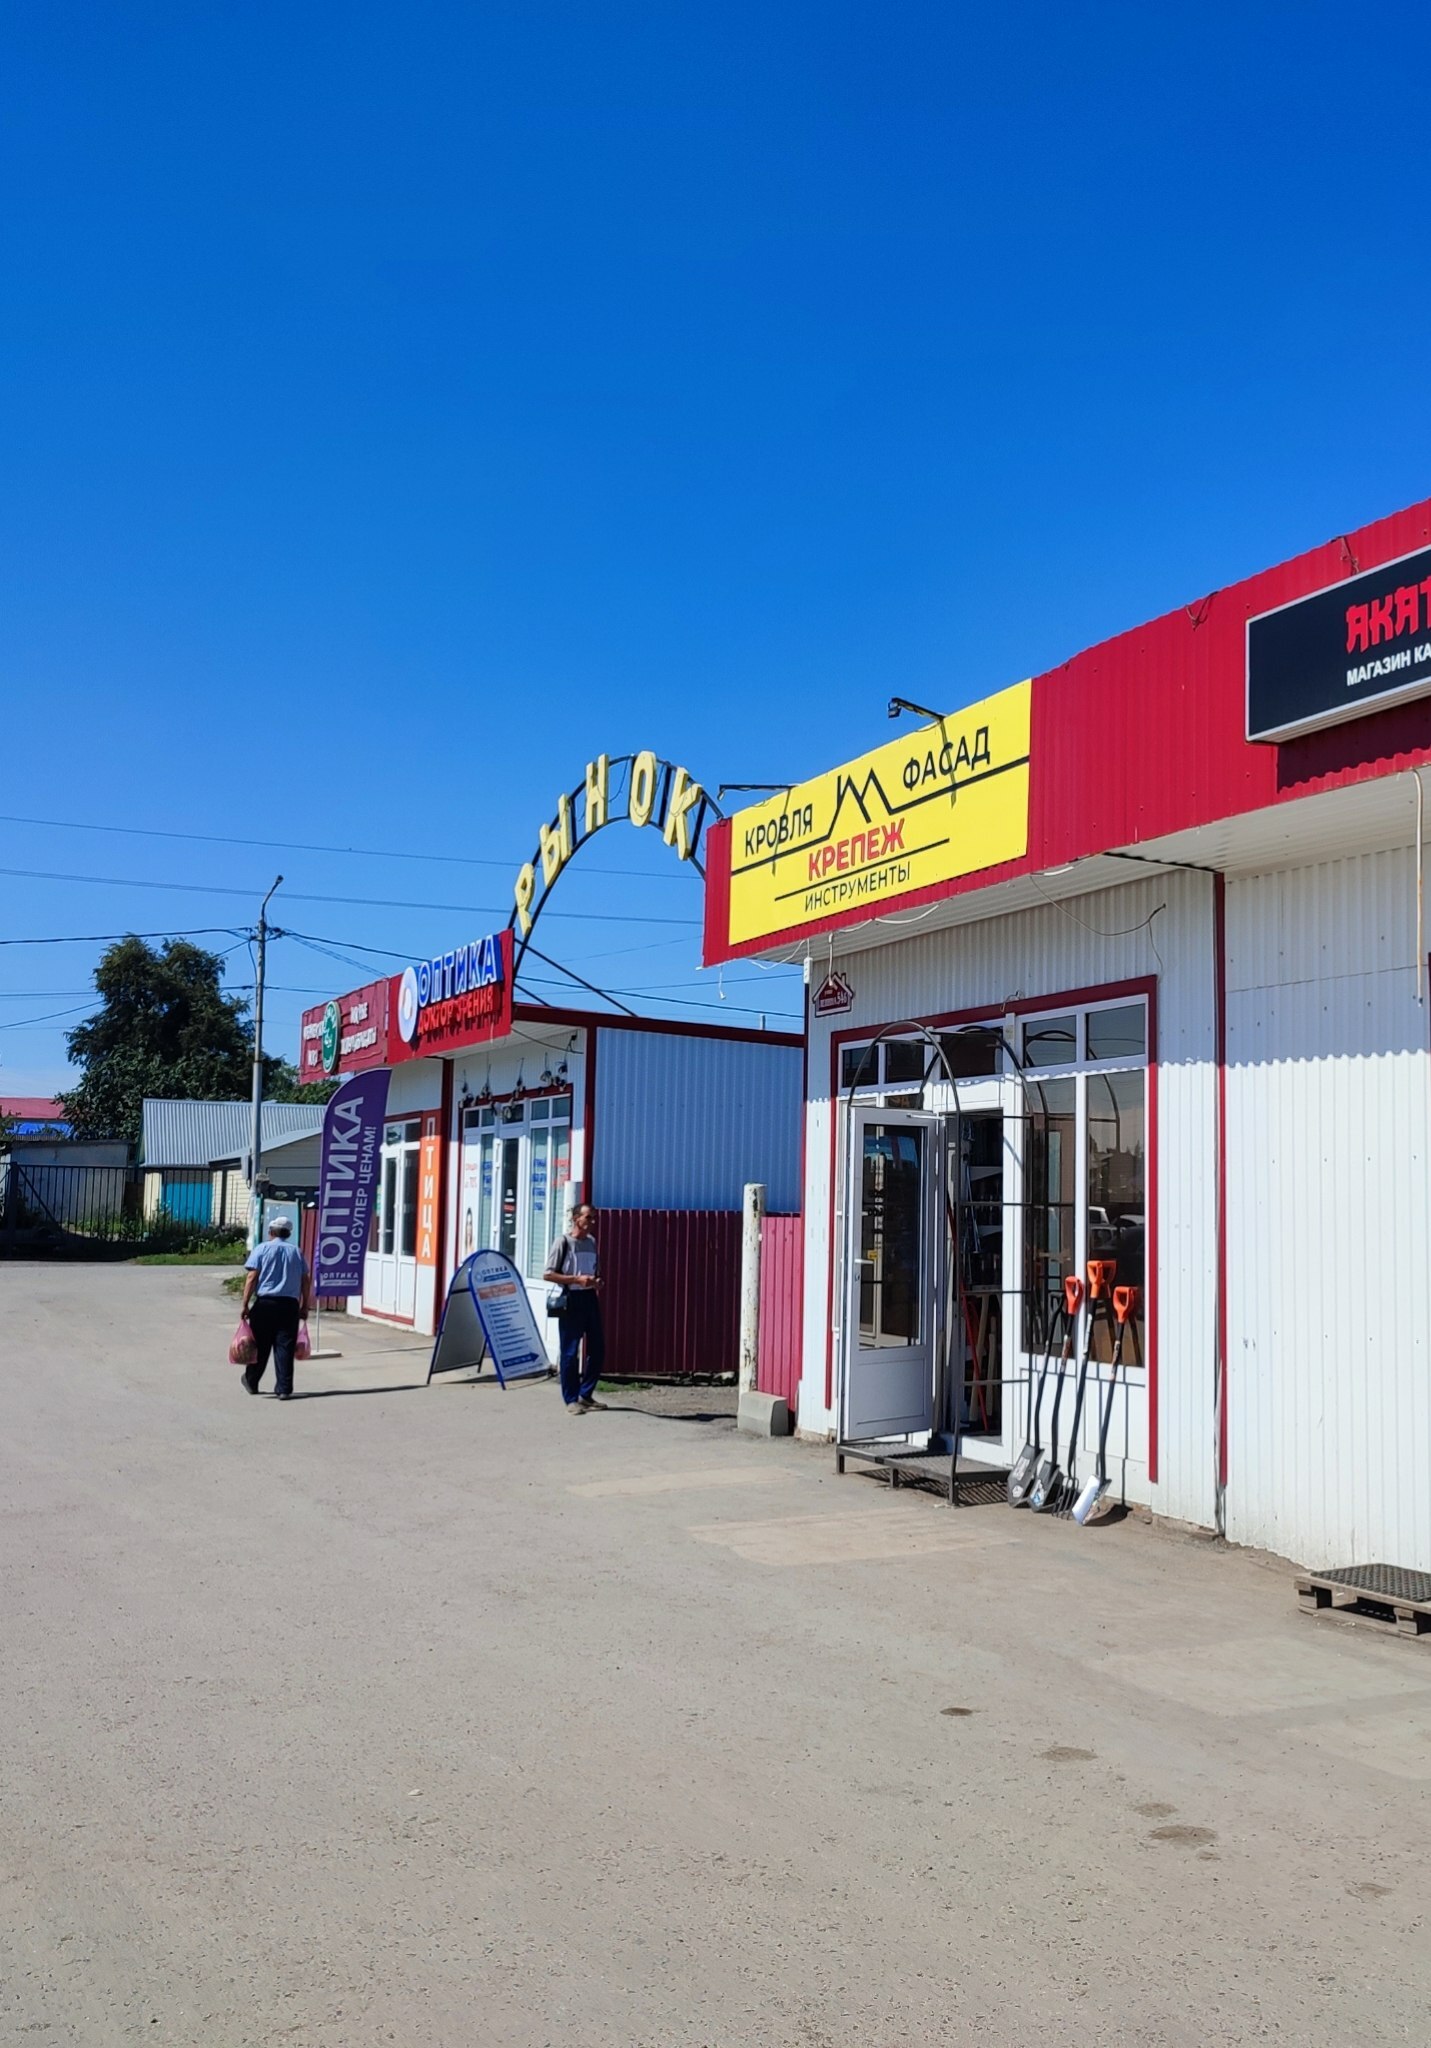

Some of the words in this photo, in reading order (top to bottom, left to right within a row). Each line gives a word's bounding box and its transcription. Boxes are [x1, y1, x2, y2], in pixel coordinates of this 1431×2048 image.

[1347, 650, 1411, 686] МАГАЗИН
[745, 803, 813, 857] КРОВЛЯ
[903, 725, 991, 791] ФАСАД
[514, 751, 704, 936] РЫНОК
[808, 817, 905, 881] КРЕПЕЖ
[804, 861, 911, 912] ИНСТРУМЕНТЫ
[418, 934, 498, 1008] ОПТИКА
[417, 999, 454, 1036] ДОКТОР
[456, 985, 494, 1021] ЗРЕНИЯ
[320, 1096, 364, 1266] ОПТИКА
[359, 1126, 377, 1184] ЦЕНАМ!
[352, 1187, 369, 1239] СУПЕР
[421, 1116, 436, 1258] ПТИЦА
[347, 1242, 361, 1264] ПО
